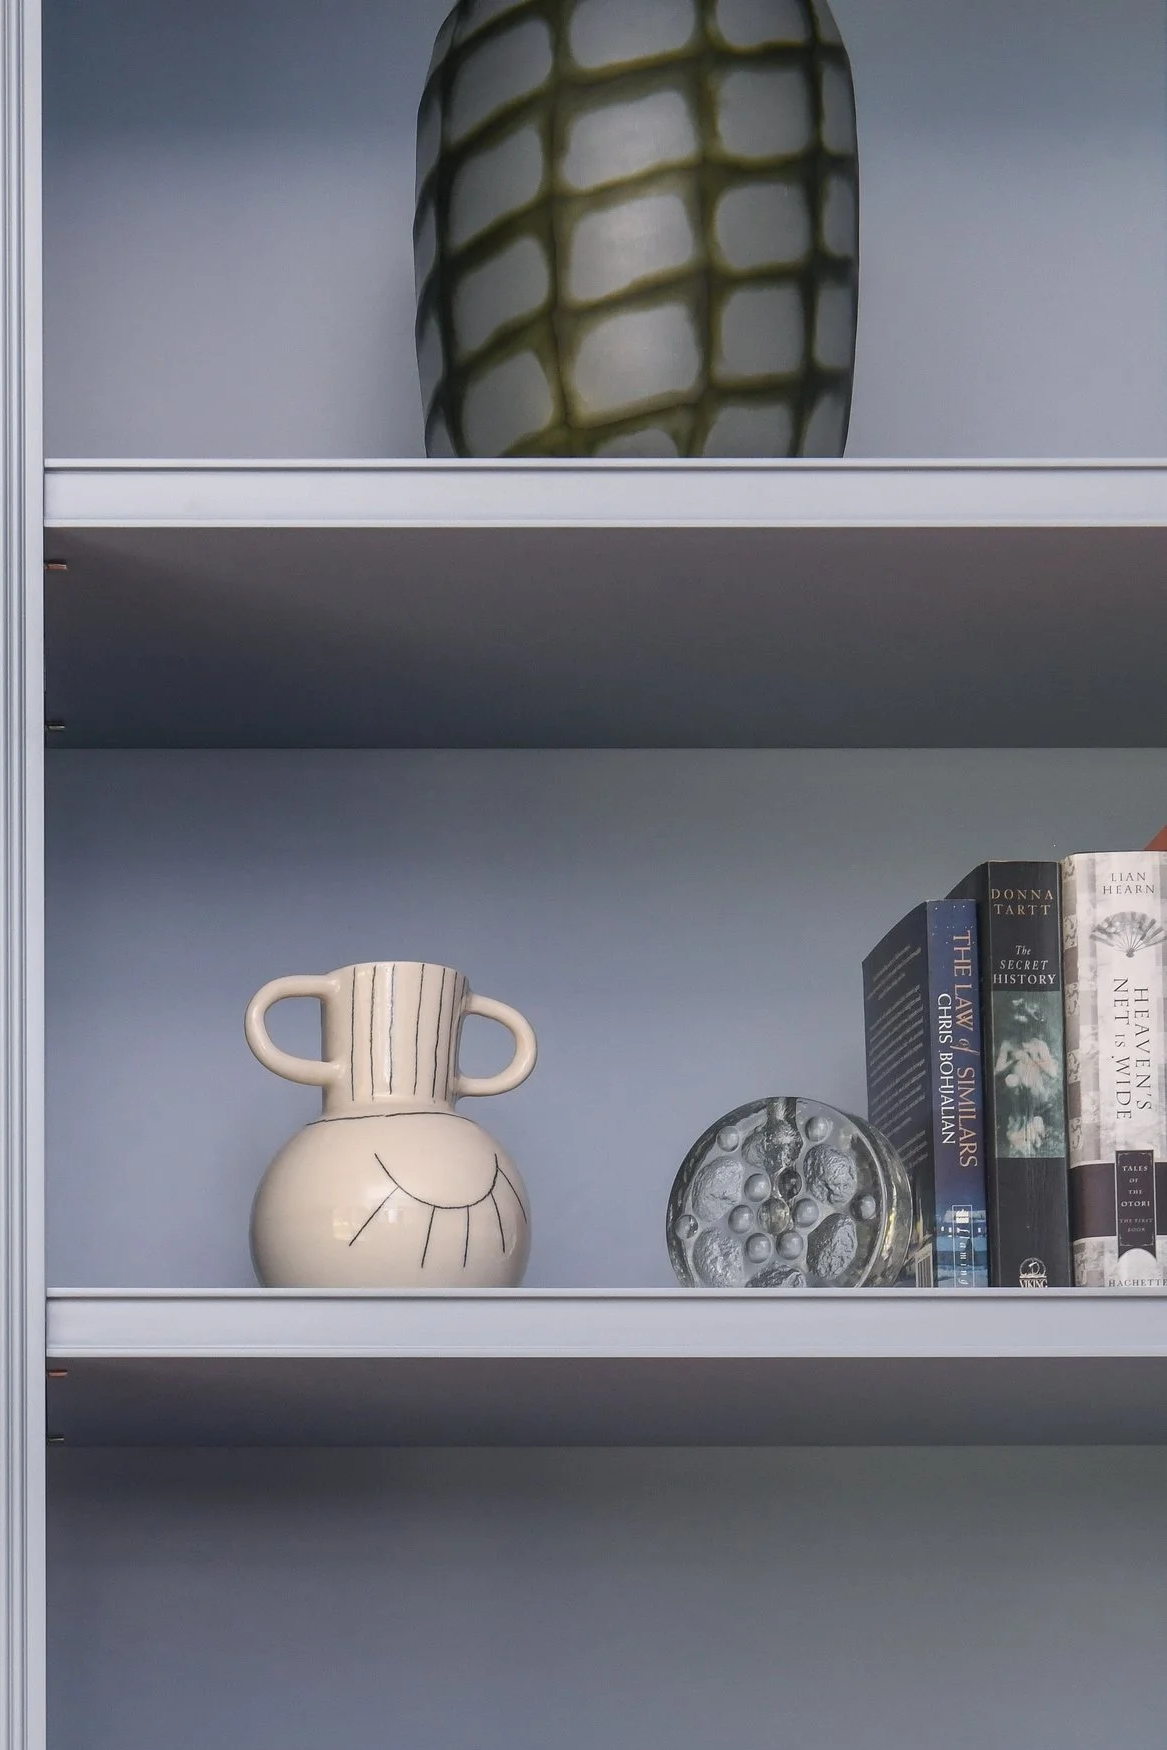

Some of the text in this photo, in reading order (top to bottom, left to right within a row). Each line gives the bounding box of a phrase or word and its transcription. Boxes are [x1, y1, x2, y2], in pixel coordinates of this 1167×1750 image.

[1111, 872, 1146, 882] LIAN
[991, 888, 1054, 900] DONNA
[1103, 884, 1155, 895] HEARN
[994, 904, 1050, 916] TARTT
[953, 929, 973, 977] THE
[1015, 944, 1031, 955] The
[999, 959, 1049, 970] SECRET
[993, 973, 1056, 985] HISTORY
[954, 983, 974, 1031] LAW
[1113, 977, 1132, 1119] NET IS WIDE
[1134, 988, 1153, 1110] HEAVEN'S
[937, 993, 955, 1144] CHRIS BOHJALIAN
[956, 1067, 978, 1167] SIMILARS
